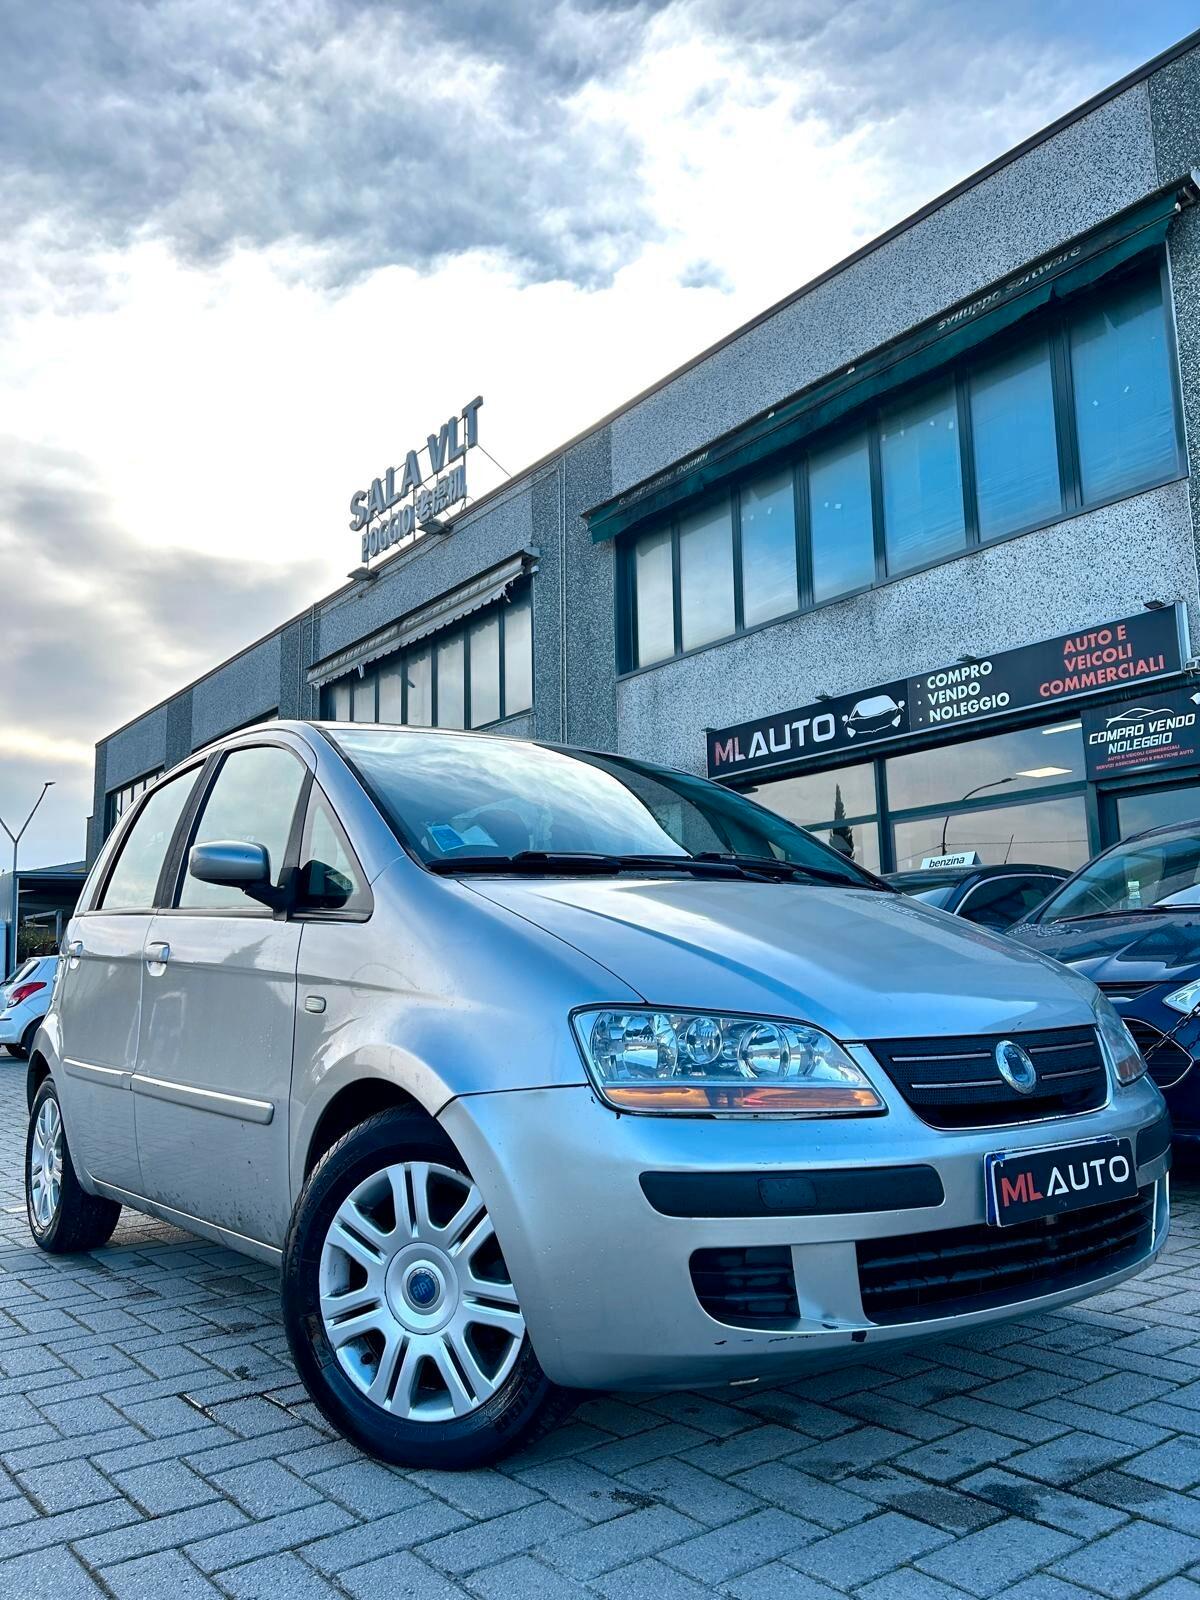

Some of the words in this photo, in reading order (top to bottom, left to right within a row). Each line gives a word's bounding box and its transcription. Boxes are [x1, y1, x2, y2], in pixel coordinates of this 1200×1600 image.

[350, 450, 422, 531] SALA
[427, 395, 483, 475] VLT
[361, 504, 415, 563] POGGIO
[1063, 629, 1112, 655] AUTO
[1117, 625, 1126, 640] E
[1064, 643, 1132, 672] VEICOLI
[927, 661, 993, 689] COMPRO
[1040, 655, 1165, 697] COMMERCIALI
[928, 681, 980, 706] VENDO
[929, 692, 1010, 723] NOLEGGIO
[715, 736, 746, 766] ML
[749, 713, 835, 759] AUTO
[1089, 724, 1144, 745] COMPRO
[1148, 713, 1195, 733] VENDO
[1108, 732, 1172, 754] NOLEGGIO
[1145, 744, 1180, 755] COMMERCIALI
[1179, 748, 1194, 756] AUTO
[929, 856, 965, 868] benzina
[1001, 1172, 1043, 1207] ML
[1047, 1155, 1130, 1196] AUTO
[412, 1279, 433, 1298] FIAT
